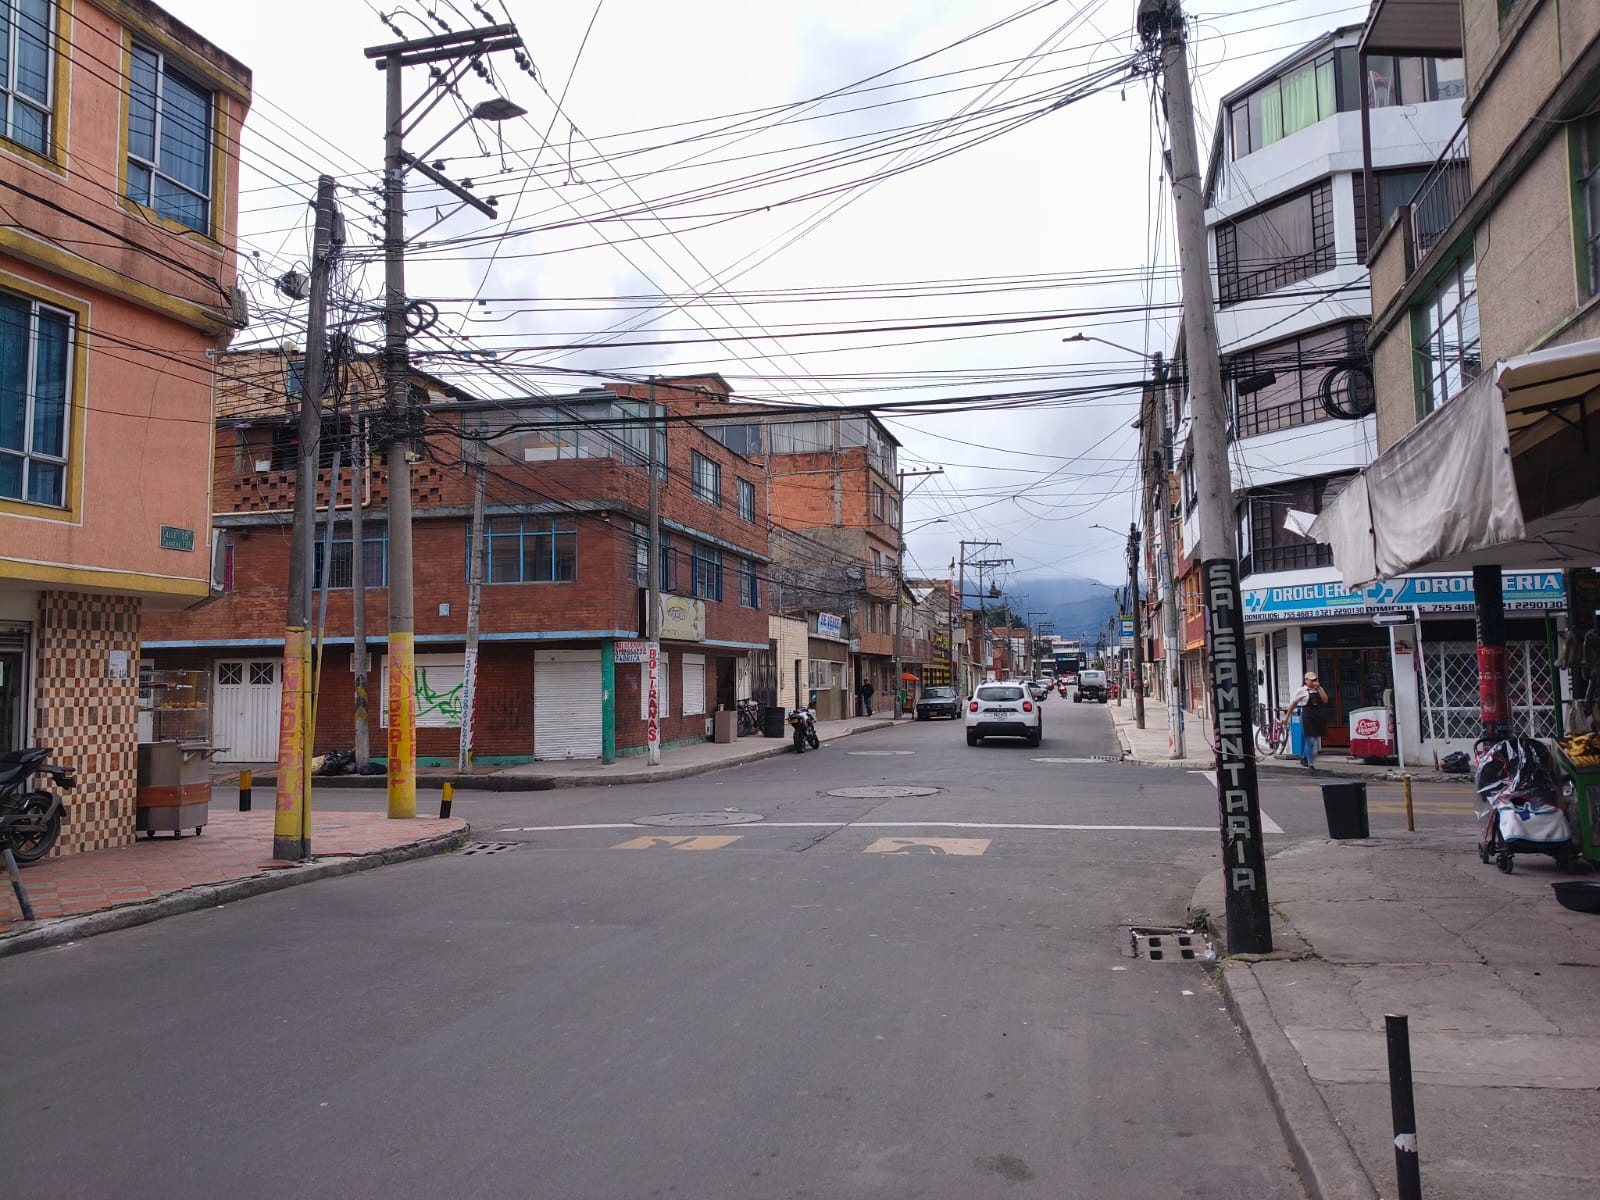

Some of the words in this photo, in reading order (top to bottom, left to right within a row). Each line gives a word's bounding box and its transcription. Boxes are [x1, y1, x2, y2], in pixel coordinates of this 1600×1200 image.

[1273, 582, 1362, 602] DROGUERI
[1414, 574, 1561, 594] DROERIA
[1431, 603, 1452, 612] 755
[1454, 603, 1475, 611] 468
[647, 648, 658, 743] BOLIRANAS
[1208, 563, 1257, 893] SALSAMENTARIA
